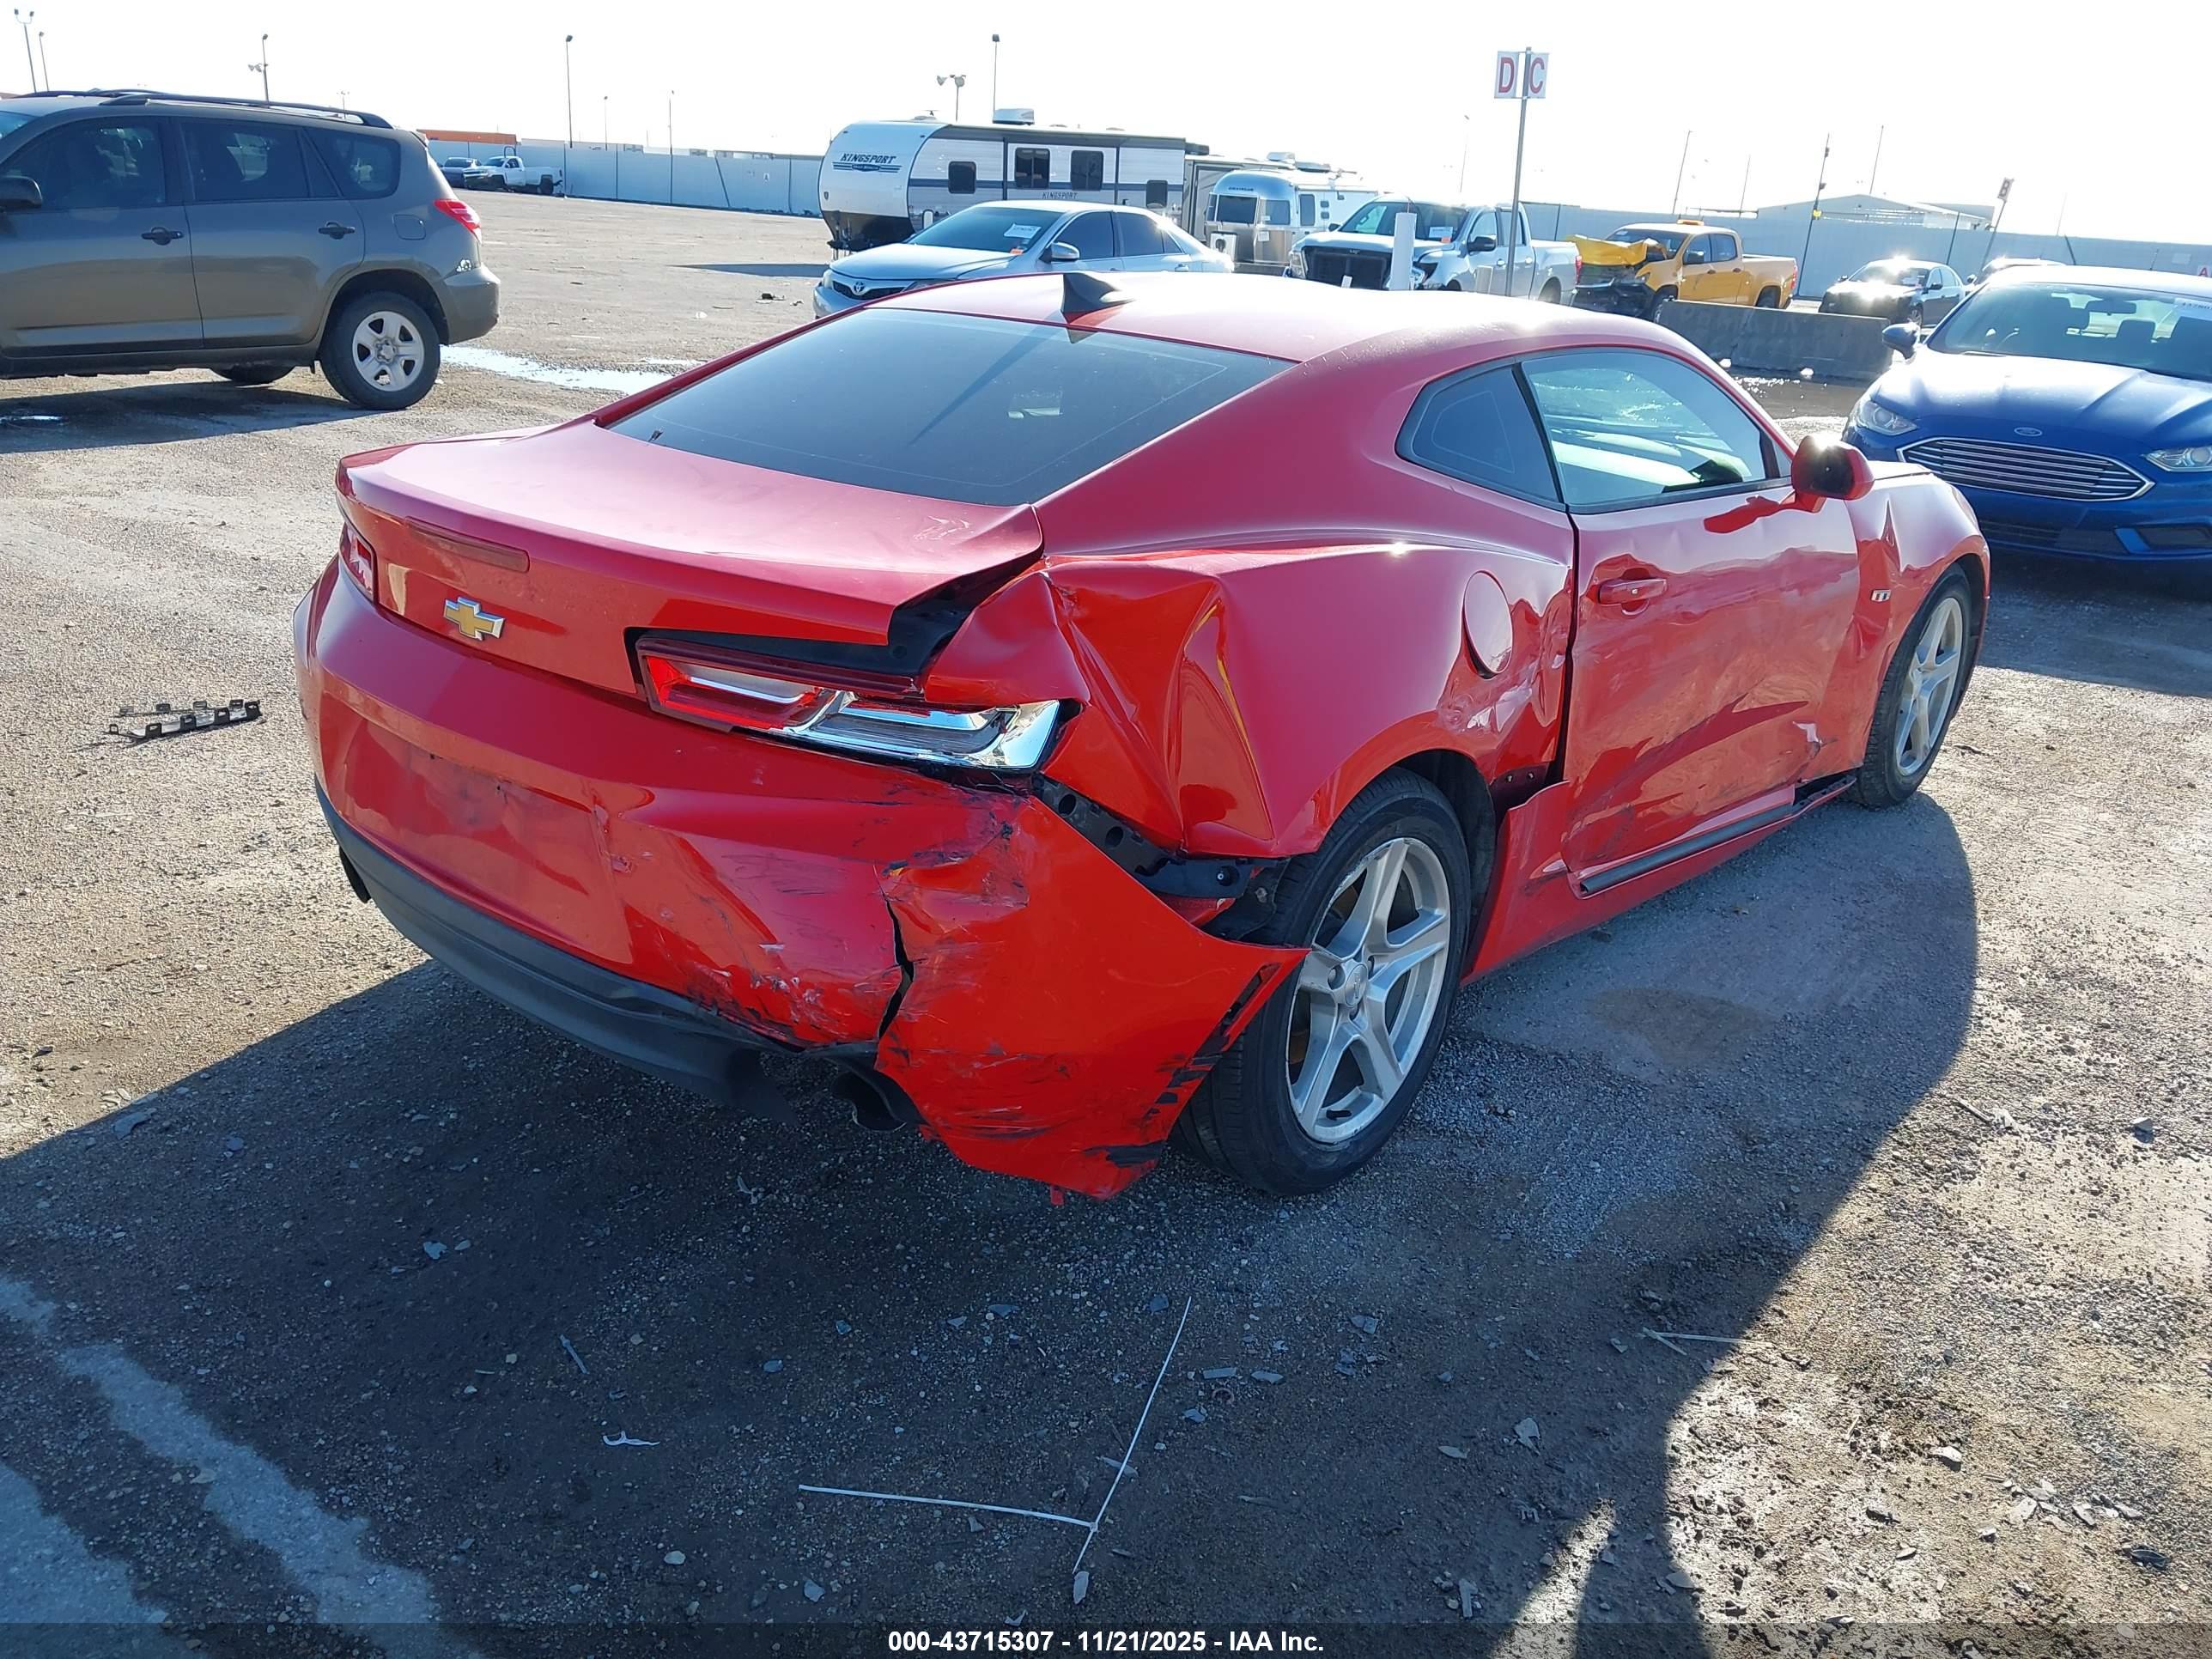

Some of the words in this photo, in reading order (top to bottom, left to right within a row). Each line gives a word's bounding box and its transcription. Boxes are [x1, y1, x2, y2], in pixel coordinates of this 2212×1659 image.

[1498, 57, 1515, 93] D
[1529, 56, 1545, 94] C
[840, 153, 896, 165] KINGSPORT
[1998, 179, 2010, 198] B
[2198, 267, 2209, 277] A
